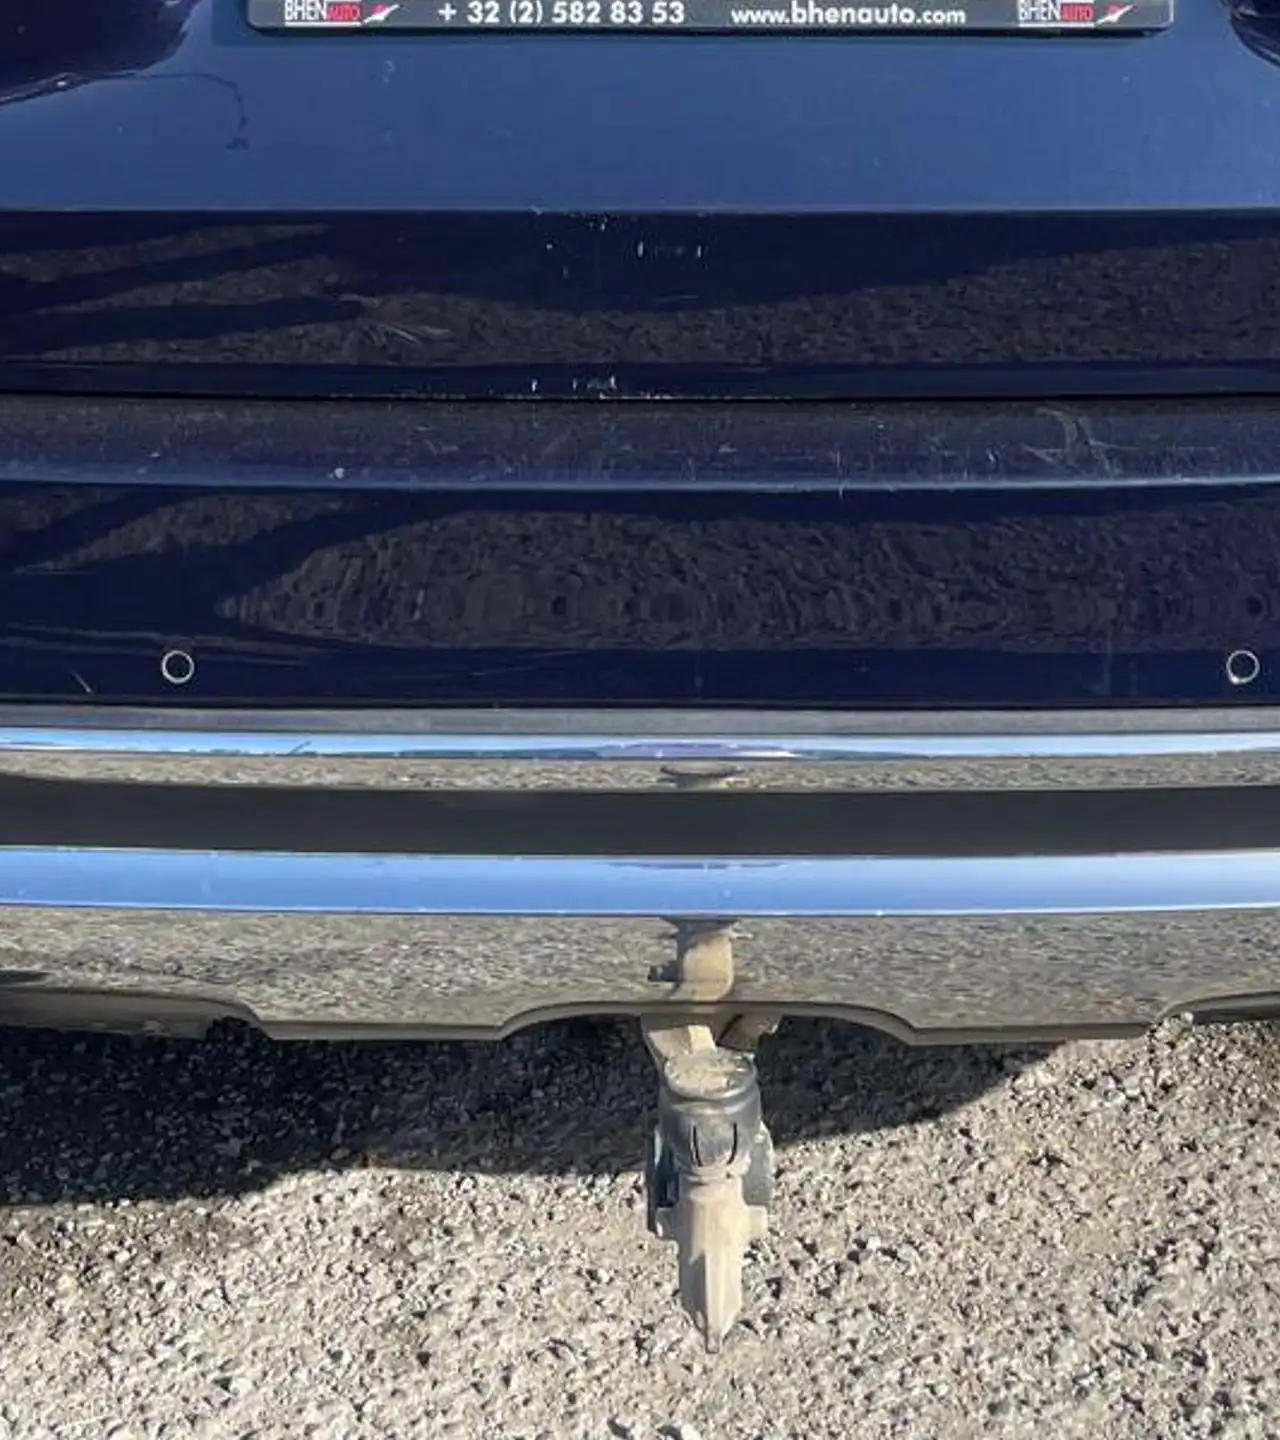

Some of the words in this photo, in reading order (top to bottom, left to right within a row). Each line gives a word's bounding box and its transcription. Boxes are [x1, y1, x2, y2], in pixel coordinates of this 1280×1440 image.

[467, 0, 500, 24] 32
[510, 0, 544, 24] (2)
[551, 0, 601, 24] 582
[610, 0, 643, 24] 83
[651, 0, 685, 24] 53
[730, 0, 966, 24] www.bhenauto.com
